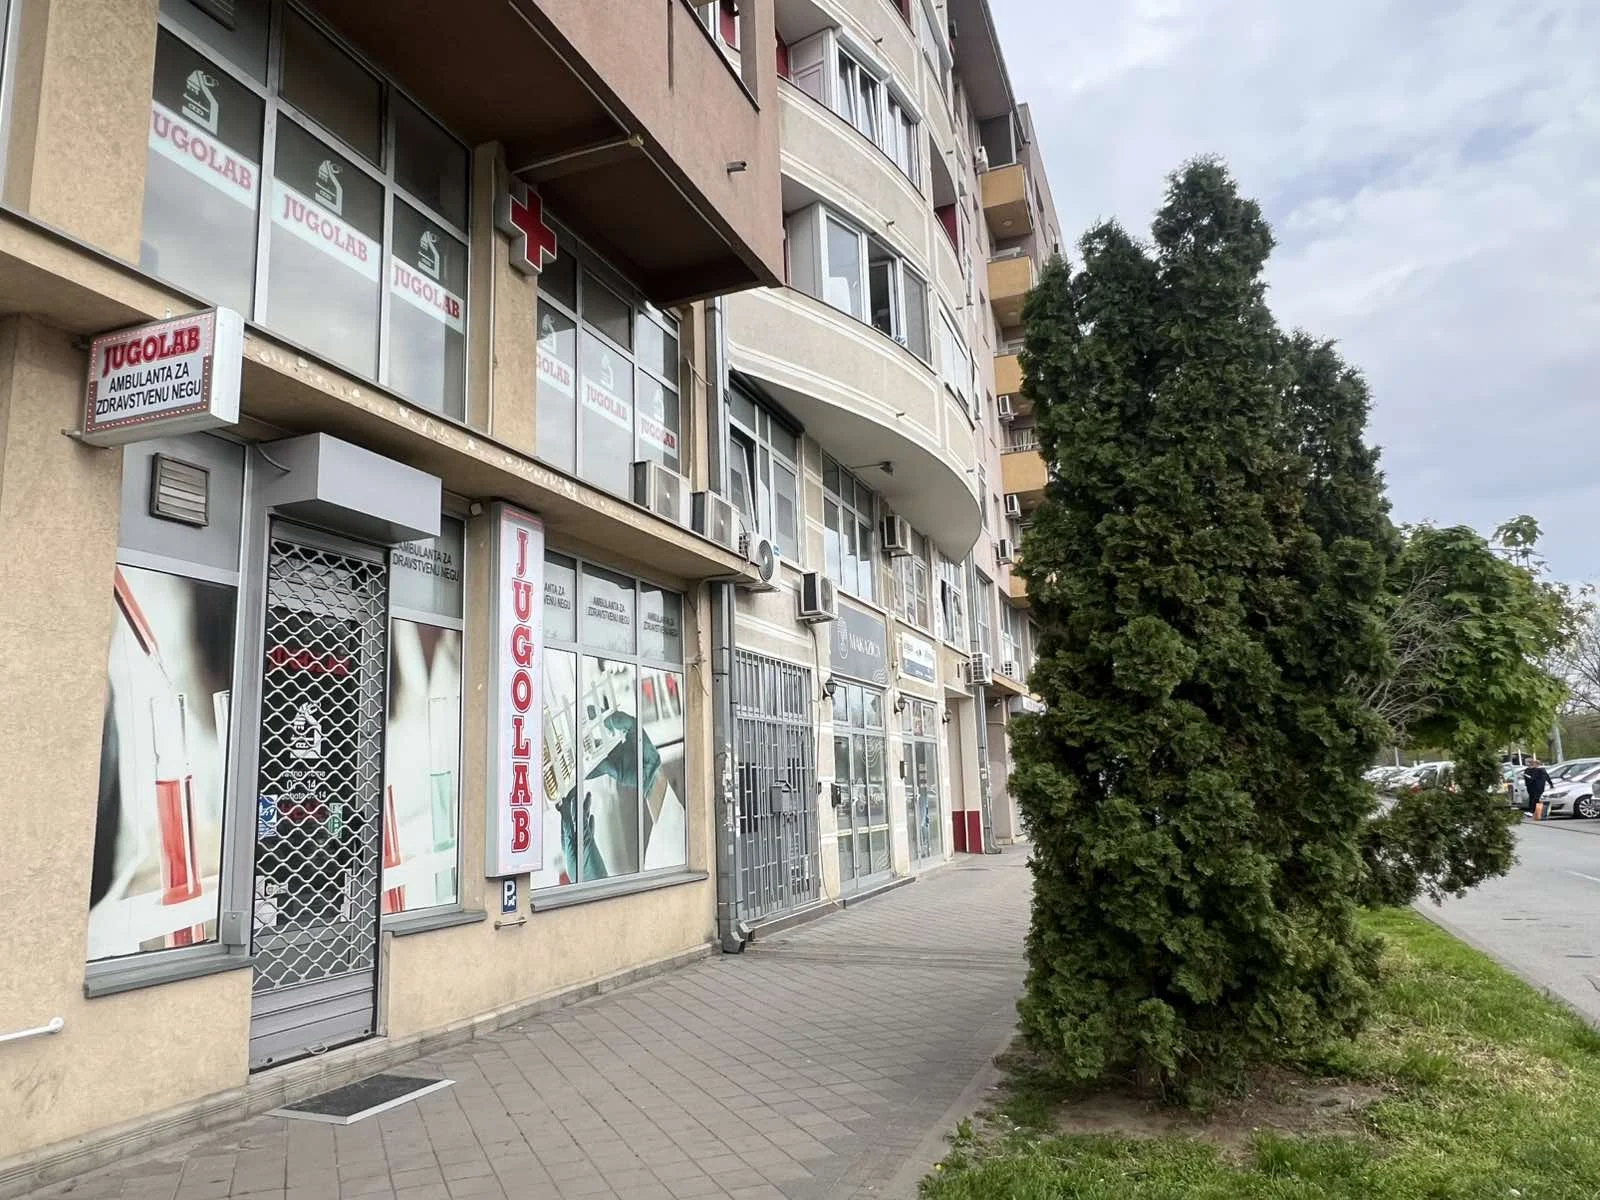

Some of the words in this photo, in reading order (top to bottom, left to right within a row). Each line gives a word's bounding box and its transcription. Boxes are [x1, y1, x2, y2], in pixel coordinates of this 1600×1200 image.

[283, 193, 368, 262] JUGOLAB
[393, 265, 460, 319] JUGOLAB
[102, 326, 201, 377] JUGOLAB
[109, 365, 172, 393] AMBULANTA
[175, 362, 190, 379] ZA
[96, 386, 169, 415] ZDRAVSTVENU
[172, 379, 201, 400] NEGU
[586, 384, 627, 421] JUGOLAB
[441, 567, 459, 581] NEGU
[443, 552, 453, 565] ZA
[511, 527, 534, 854] JUGOLAB
[307, 779, 316, 790] 14
[504, 881, 516, 905] P
